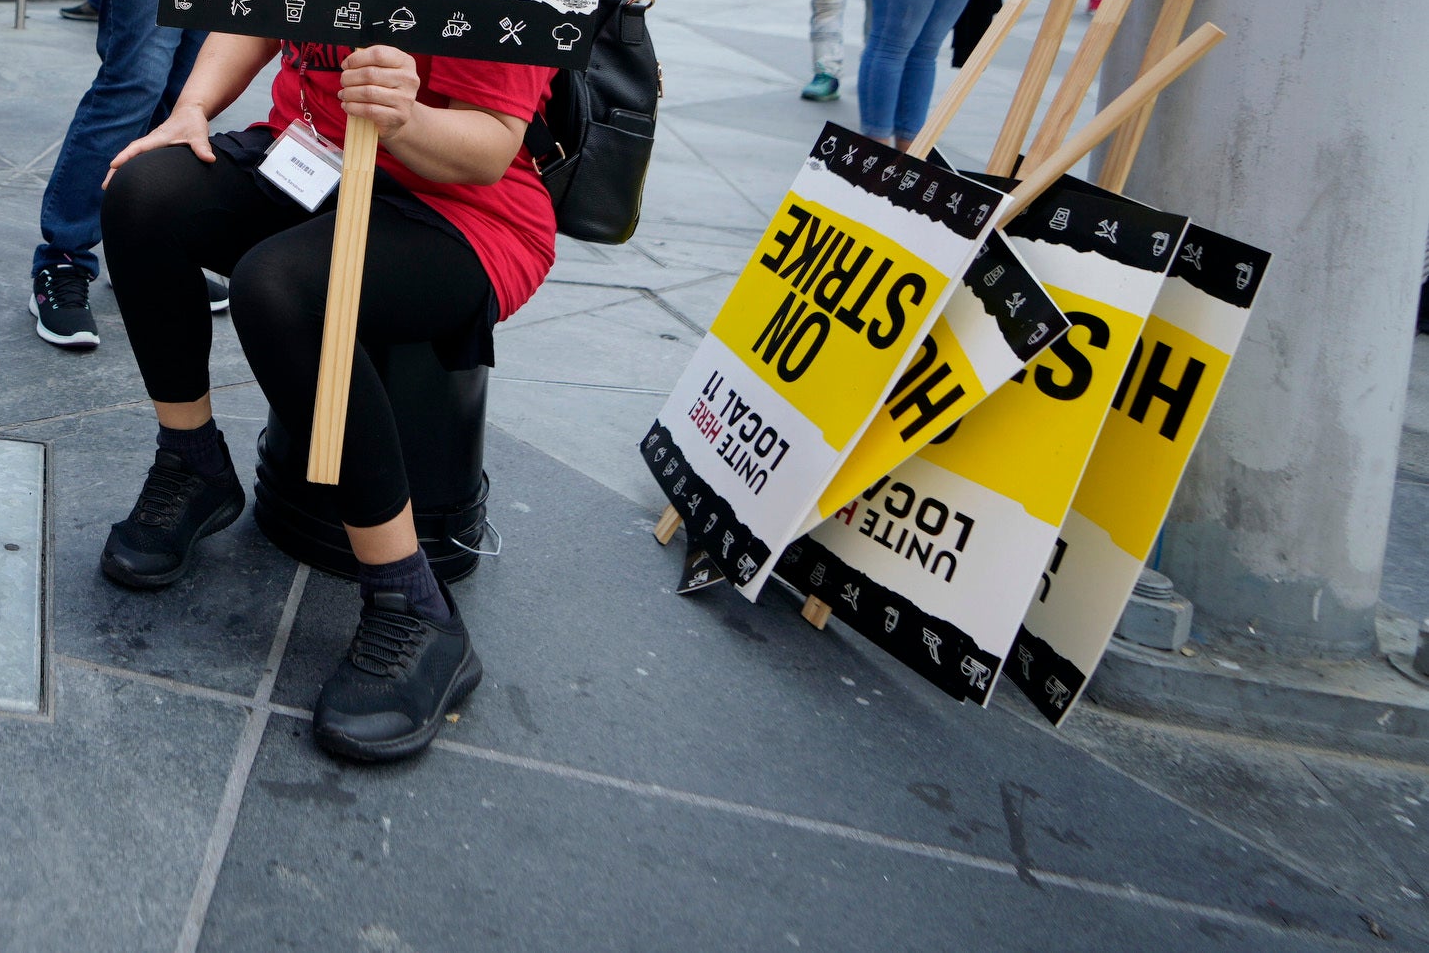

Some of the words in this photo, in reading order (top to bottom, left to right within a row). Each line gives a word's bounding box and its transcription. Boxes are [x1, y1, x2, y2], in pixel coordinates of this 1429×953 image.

[759, 204, 927, 350] STRIKE
[751, 290, 832, 383] ON
[689, 398, 723, 445] HERE!
[702, 370, 725, 403] 11
[716, 433, 769, 496] UNITE
[719, 389, 791, 472] LOCAL
[858, 508, 958, 584] UNITE
[861, 475, 975, 553] LOC
